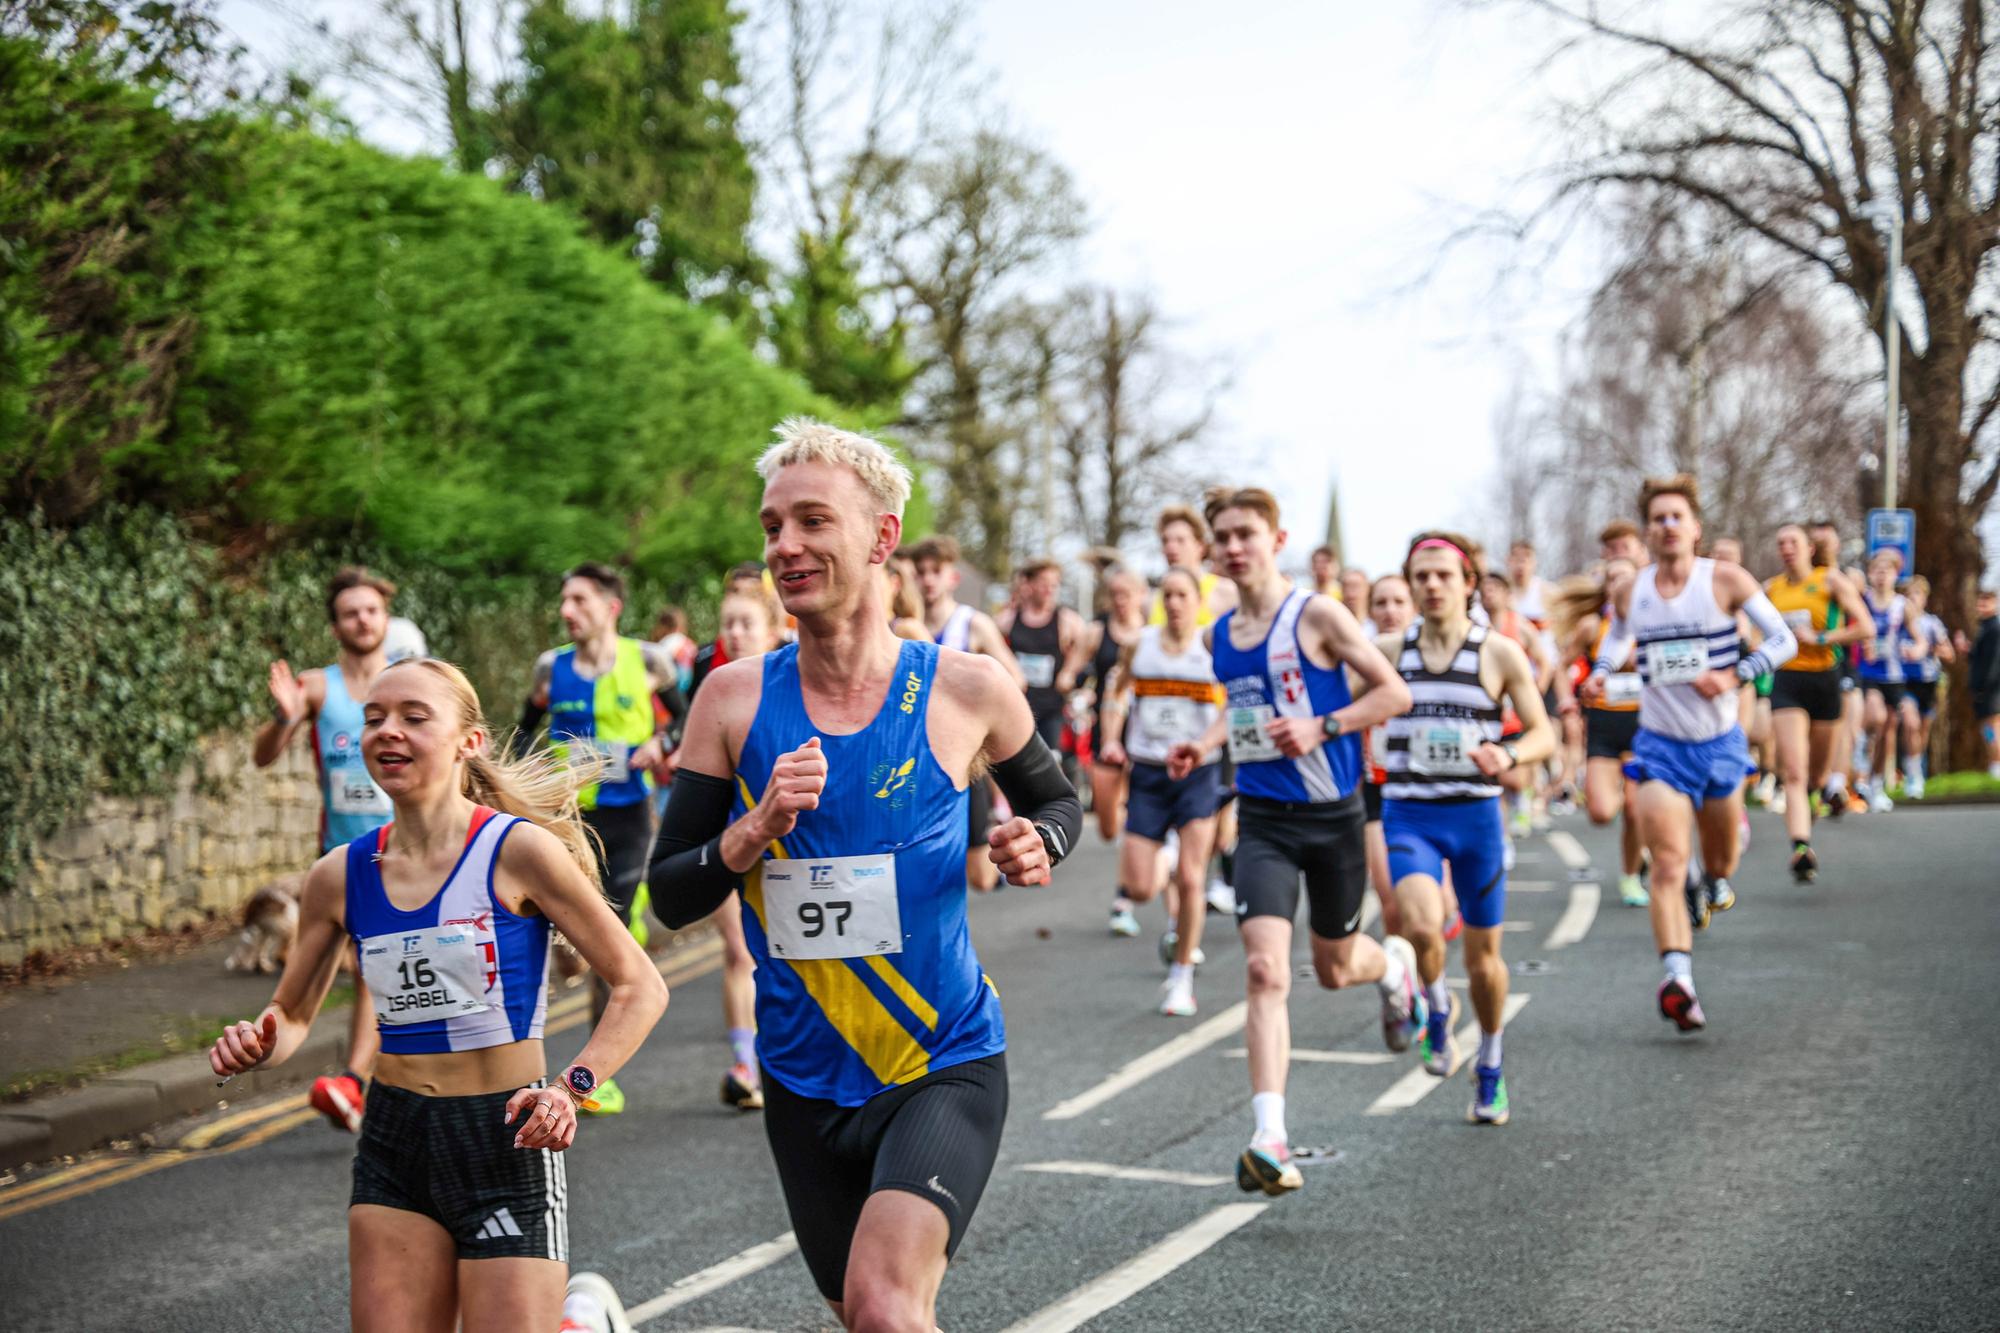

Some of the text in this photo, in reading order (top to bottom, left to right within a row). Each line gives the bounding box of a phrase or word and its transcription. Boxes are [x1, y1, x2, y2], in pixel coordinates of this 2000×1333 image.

[899, 670, 922, 715] soar
[797, 901, 853, 938] 97
[398, 958, 436, 990] 16
[387, 989, 457, 1012] ISABEL
